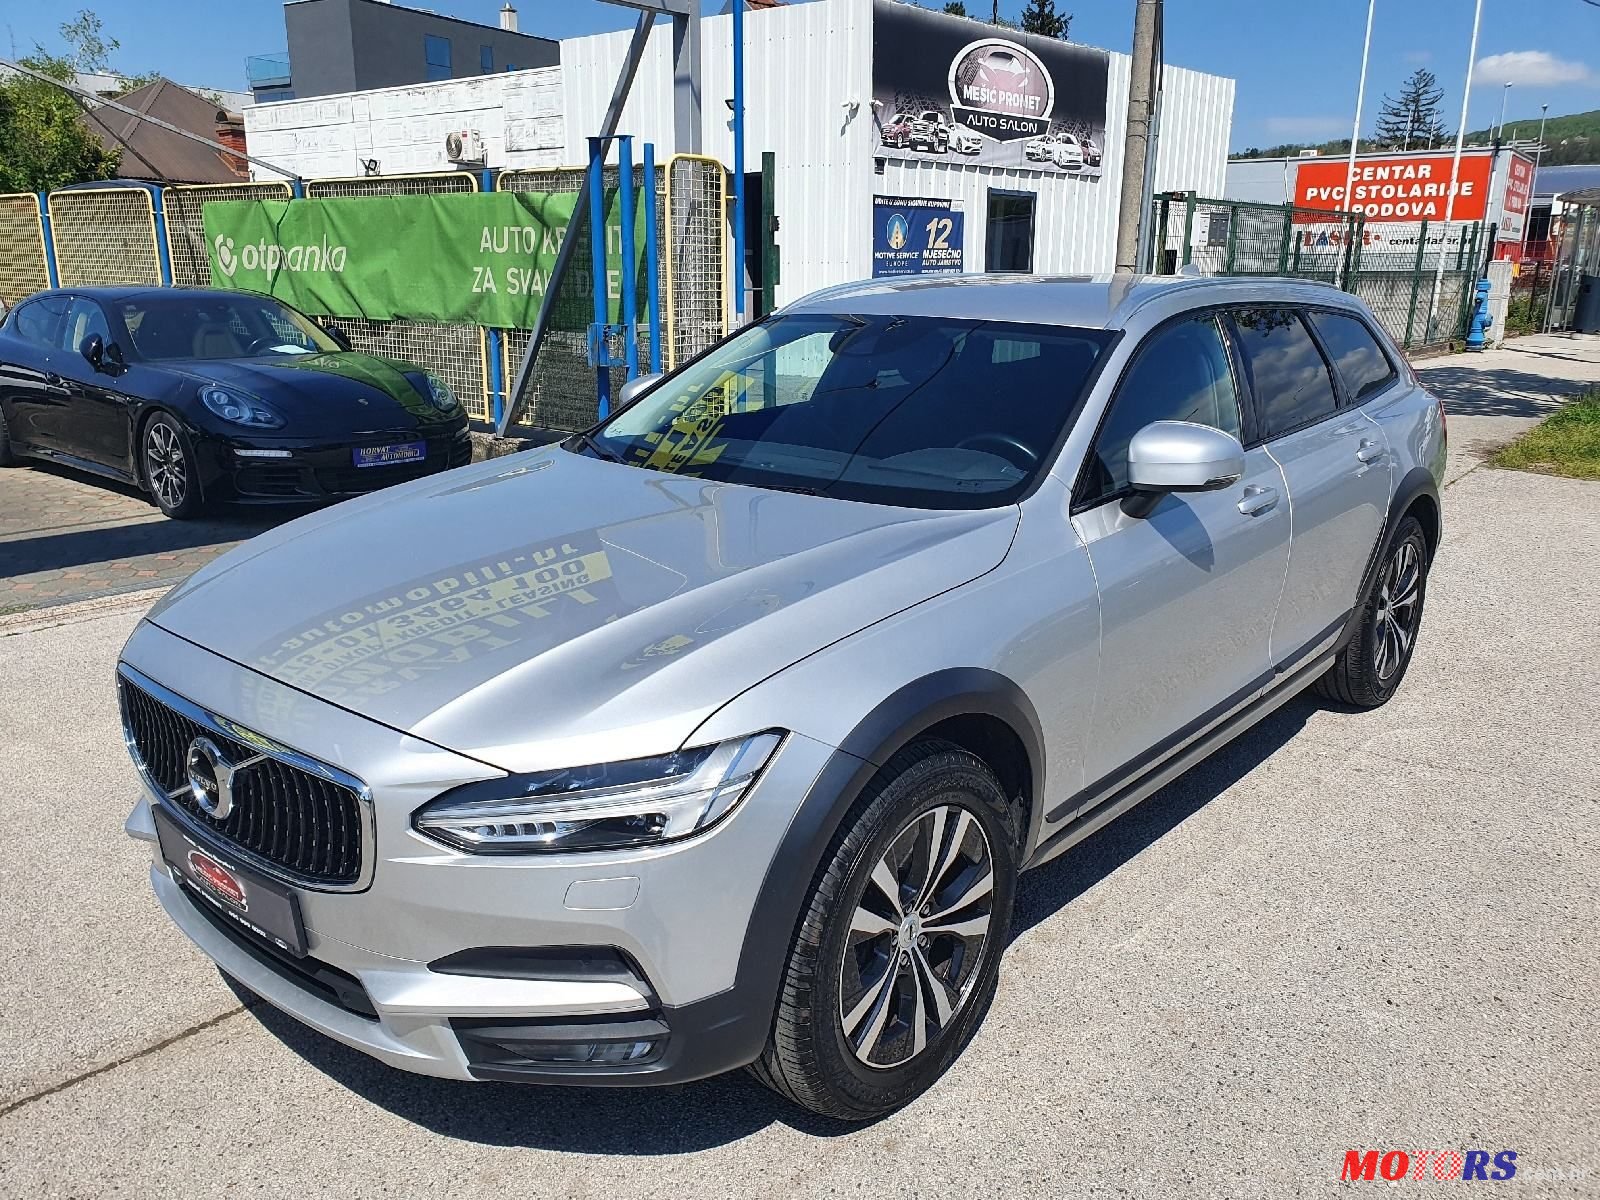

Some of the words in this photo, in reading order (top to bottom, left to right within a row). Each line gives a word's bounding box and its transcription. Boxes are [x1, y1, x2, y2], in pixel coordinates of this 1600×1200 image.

[999, 89, 1041, 111] PROMET
[966, 114, 997, 128] AUTO
[1000, 118, 1038, 134] SALON
[1350, 164, 1432, 182] CENTAR
[1306, 186, 1345, 201] PVC
[479, 226, 535, 254] AUTO
[926, 217, 953, 249] 12
[874, 251, 896, 259] MOTIVE
[471, 266, 497, 294] ZA
[360, 445, 390, 455] HORVAT
